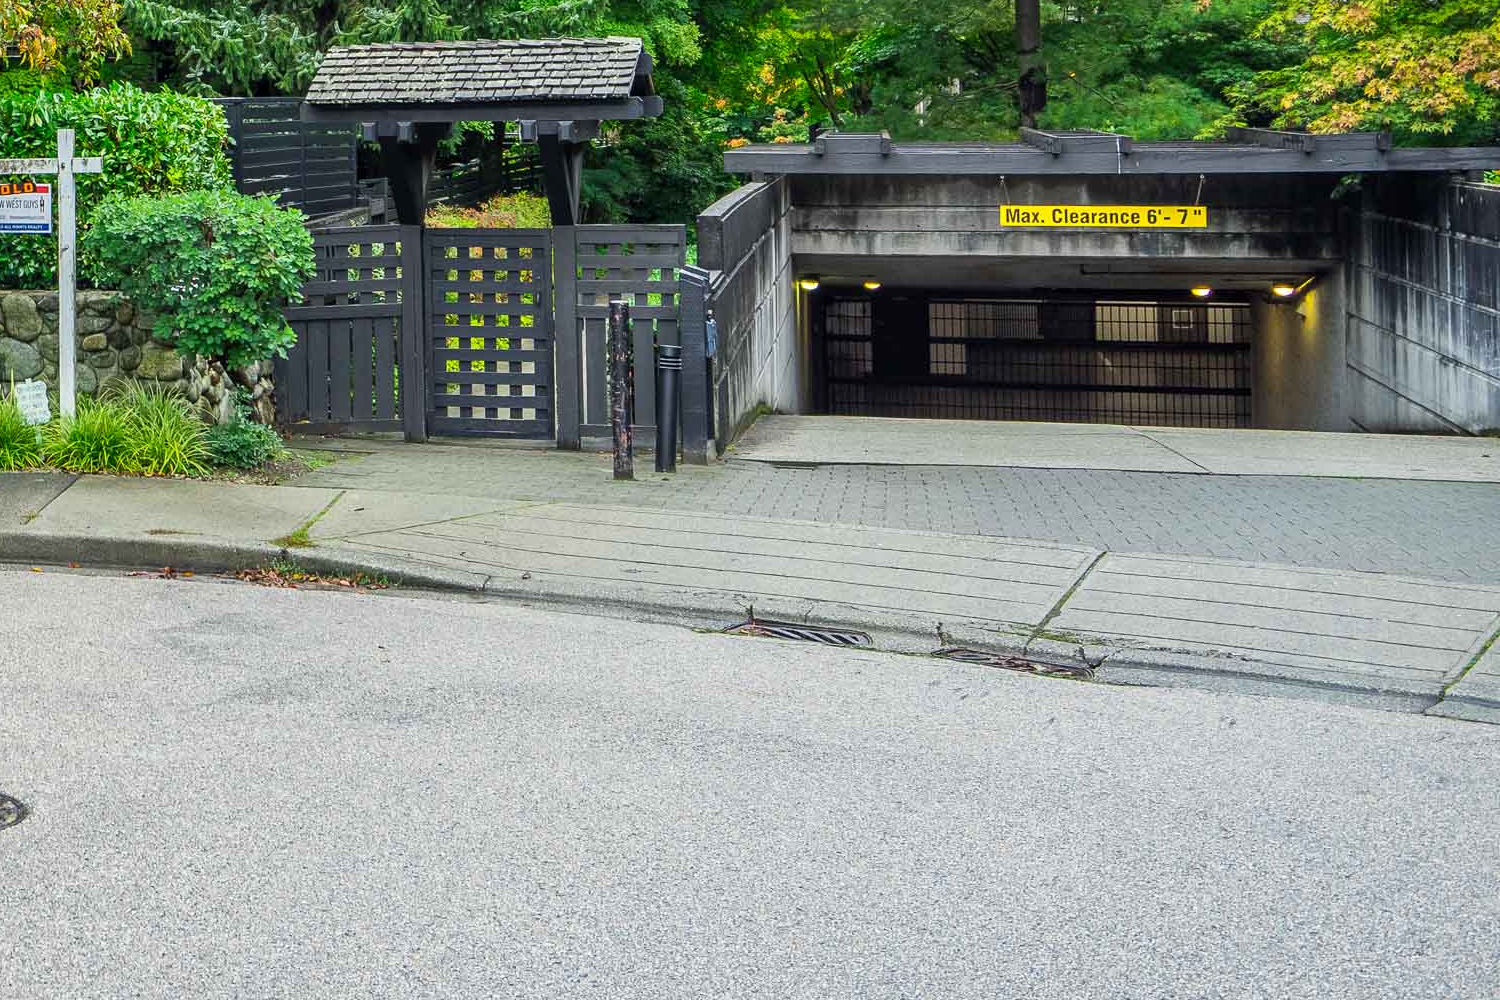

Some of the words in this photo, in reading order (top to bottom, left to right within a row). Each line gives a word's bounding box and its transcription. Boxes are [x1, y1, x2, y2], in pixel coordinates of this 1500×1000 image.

[6, 199, 22, 209] WEST
[23, 199, 39, 209] GUYS
[1006, 208, 1045, 223] Max.
[1052, 208, 1140, 224] Clearance
